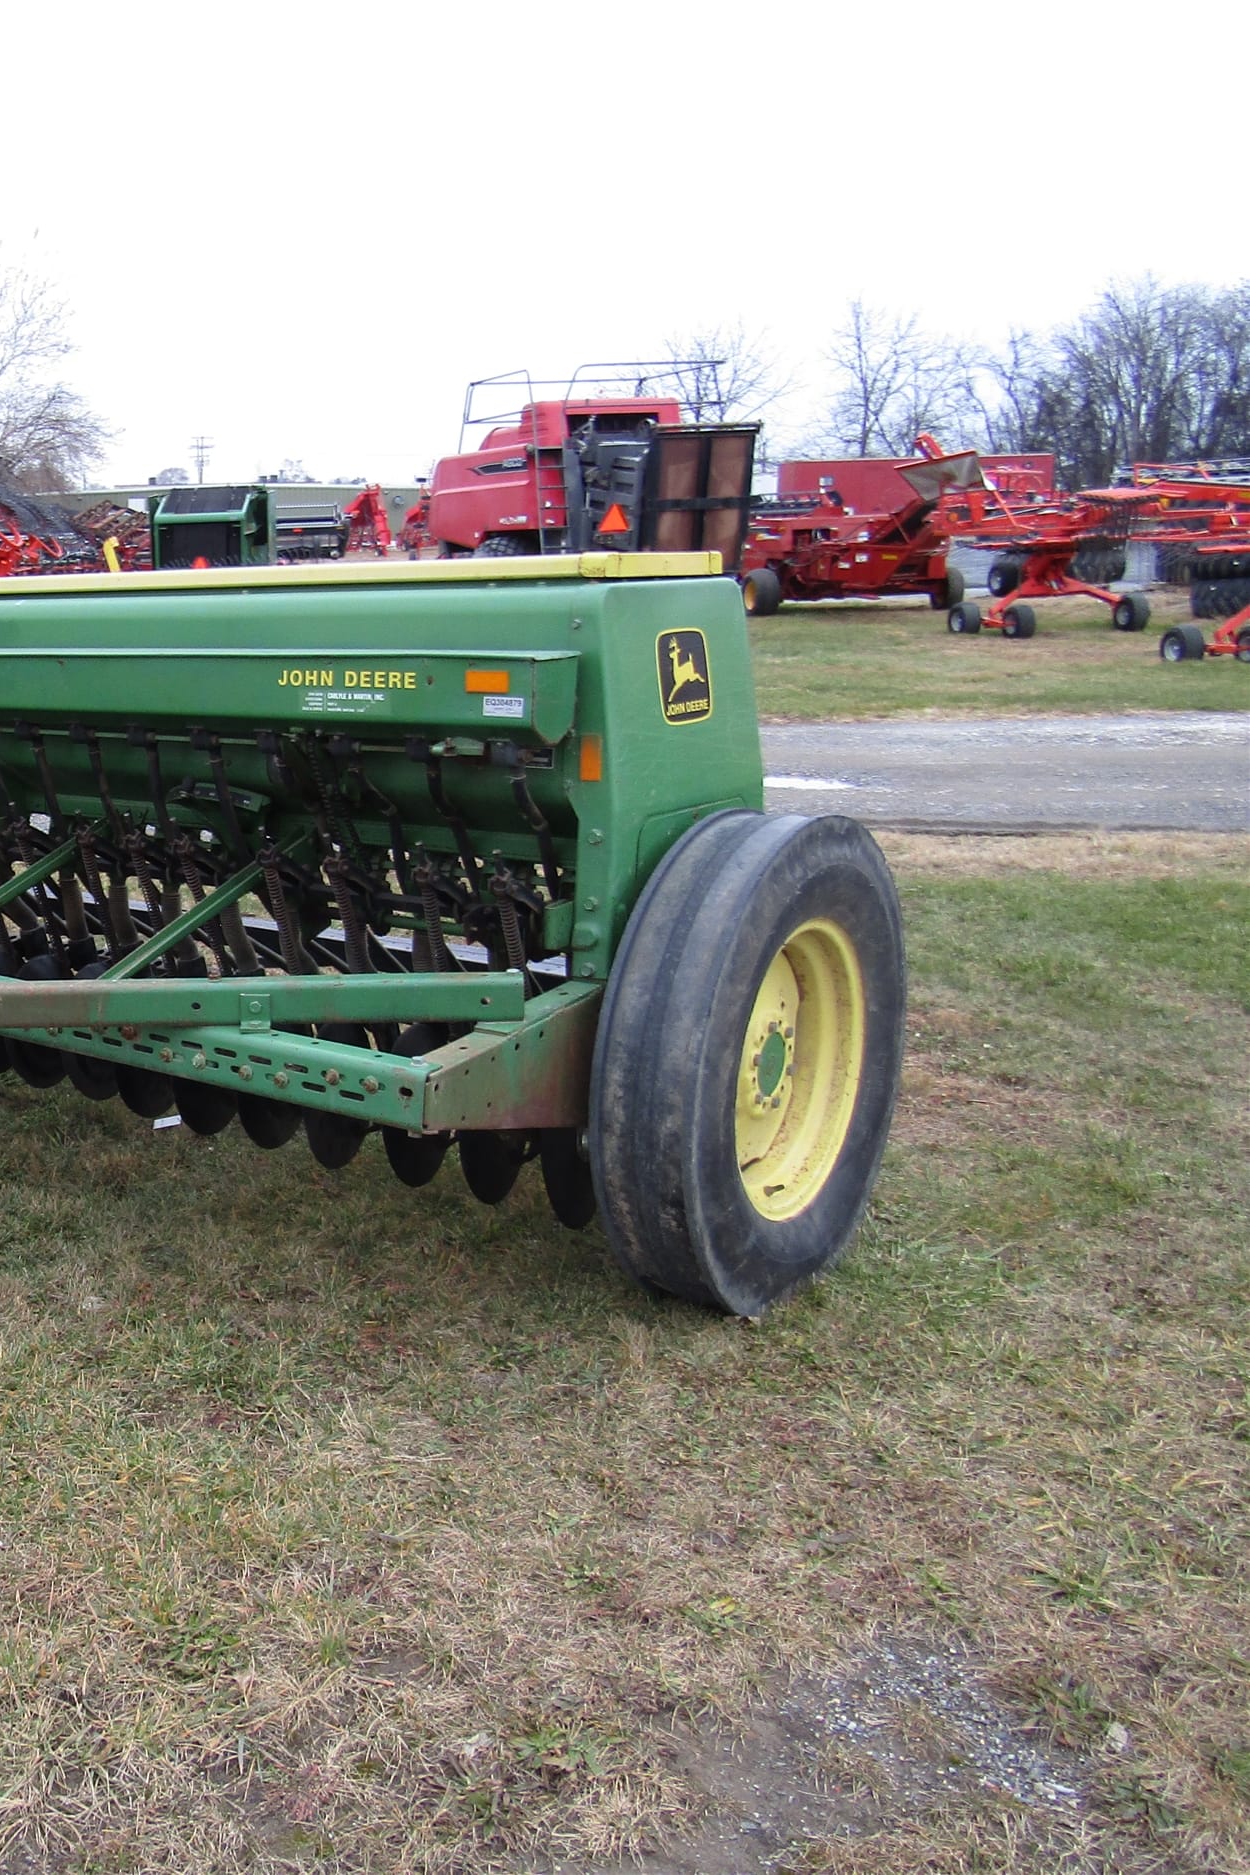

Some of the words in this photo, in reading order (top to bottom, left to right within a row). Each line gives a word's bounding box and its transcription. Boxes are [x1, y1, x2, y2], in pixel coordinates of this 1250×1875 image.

[278, 670, 333, 686] JOHN
[344, 671, 417, 689] DEERE
[666, 702, 686, 716] JOHN
[686, 699, 709, 712] DEERE
